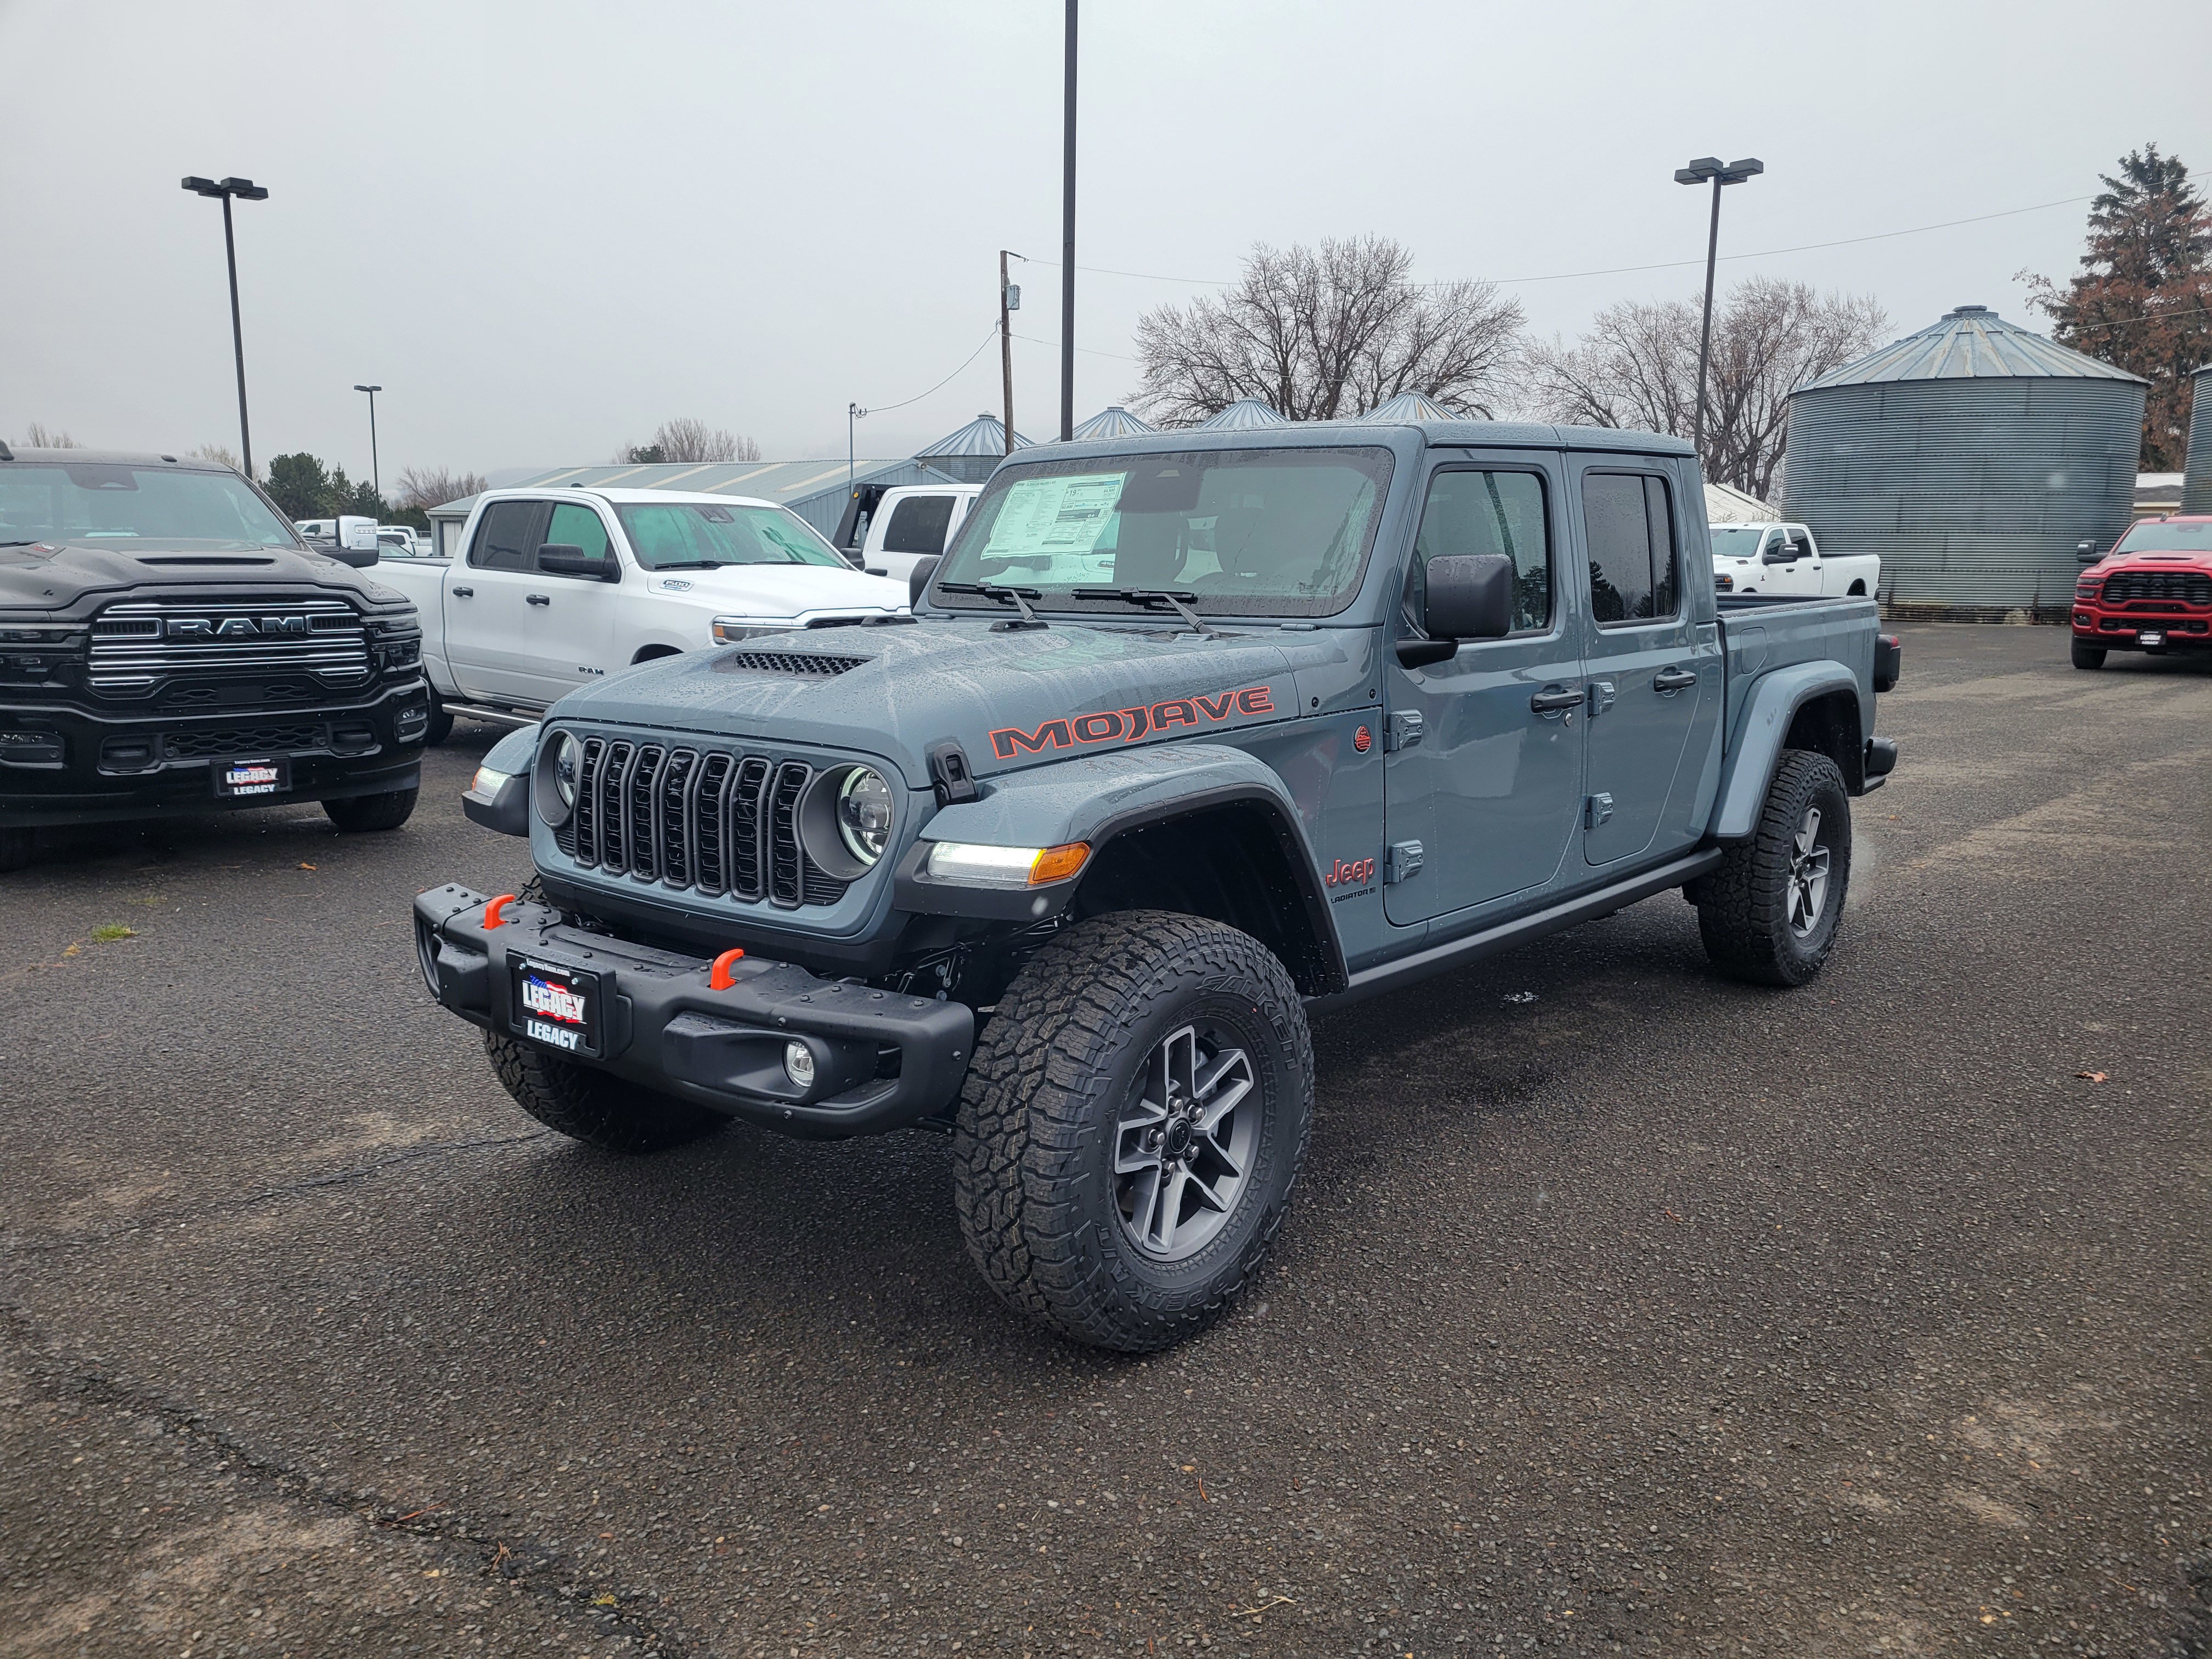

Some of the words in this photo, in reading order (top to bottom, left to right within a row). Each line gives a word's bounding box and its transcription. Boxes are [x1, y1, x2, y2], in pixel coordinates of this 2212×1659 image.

[167, 617, 303, 635] RAM
[578, 665, 604, 676] RAM
[989, 686, 1275, 759] MOJAVE
[226, 768, 278, 784] LEGACY
[234, 784, 275, 795] LEGACY
[1326, 858, 1375, 888] Jeep
[1330, 889, 1369, 904] LADIATOR
[522, 981, 585, 1021] LEGACY
[1195, 974, 1298, 1070] FALKEN
[527, 1019, 578, 1050] LEGACY
